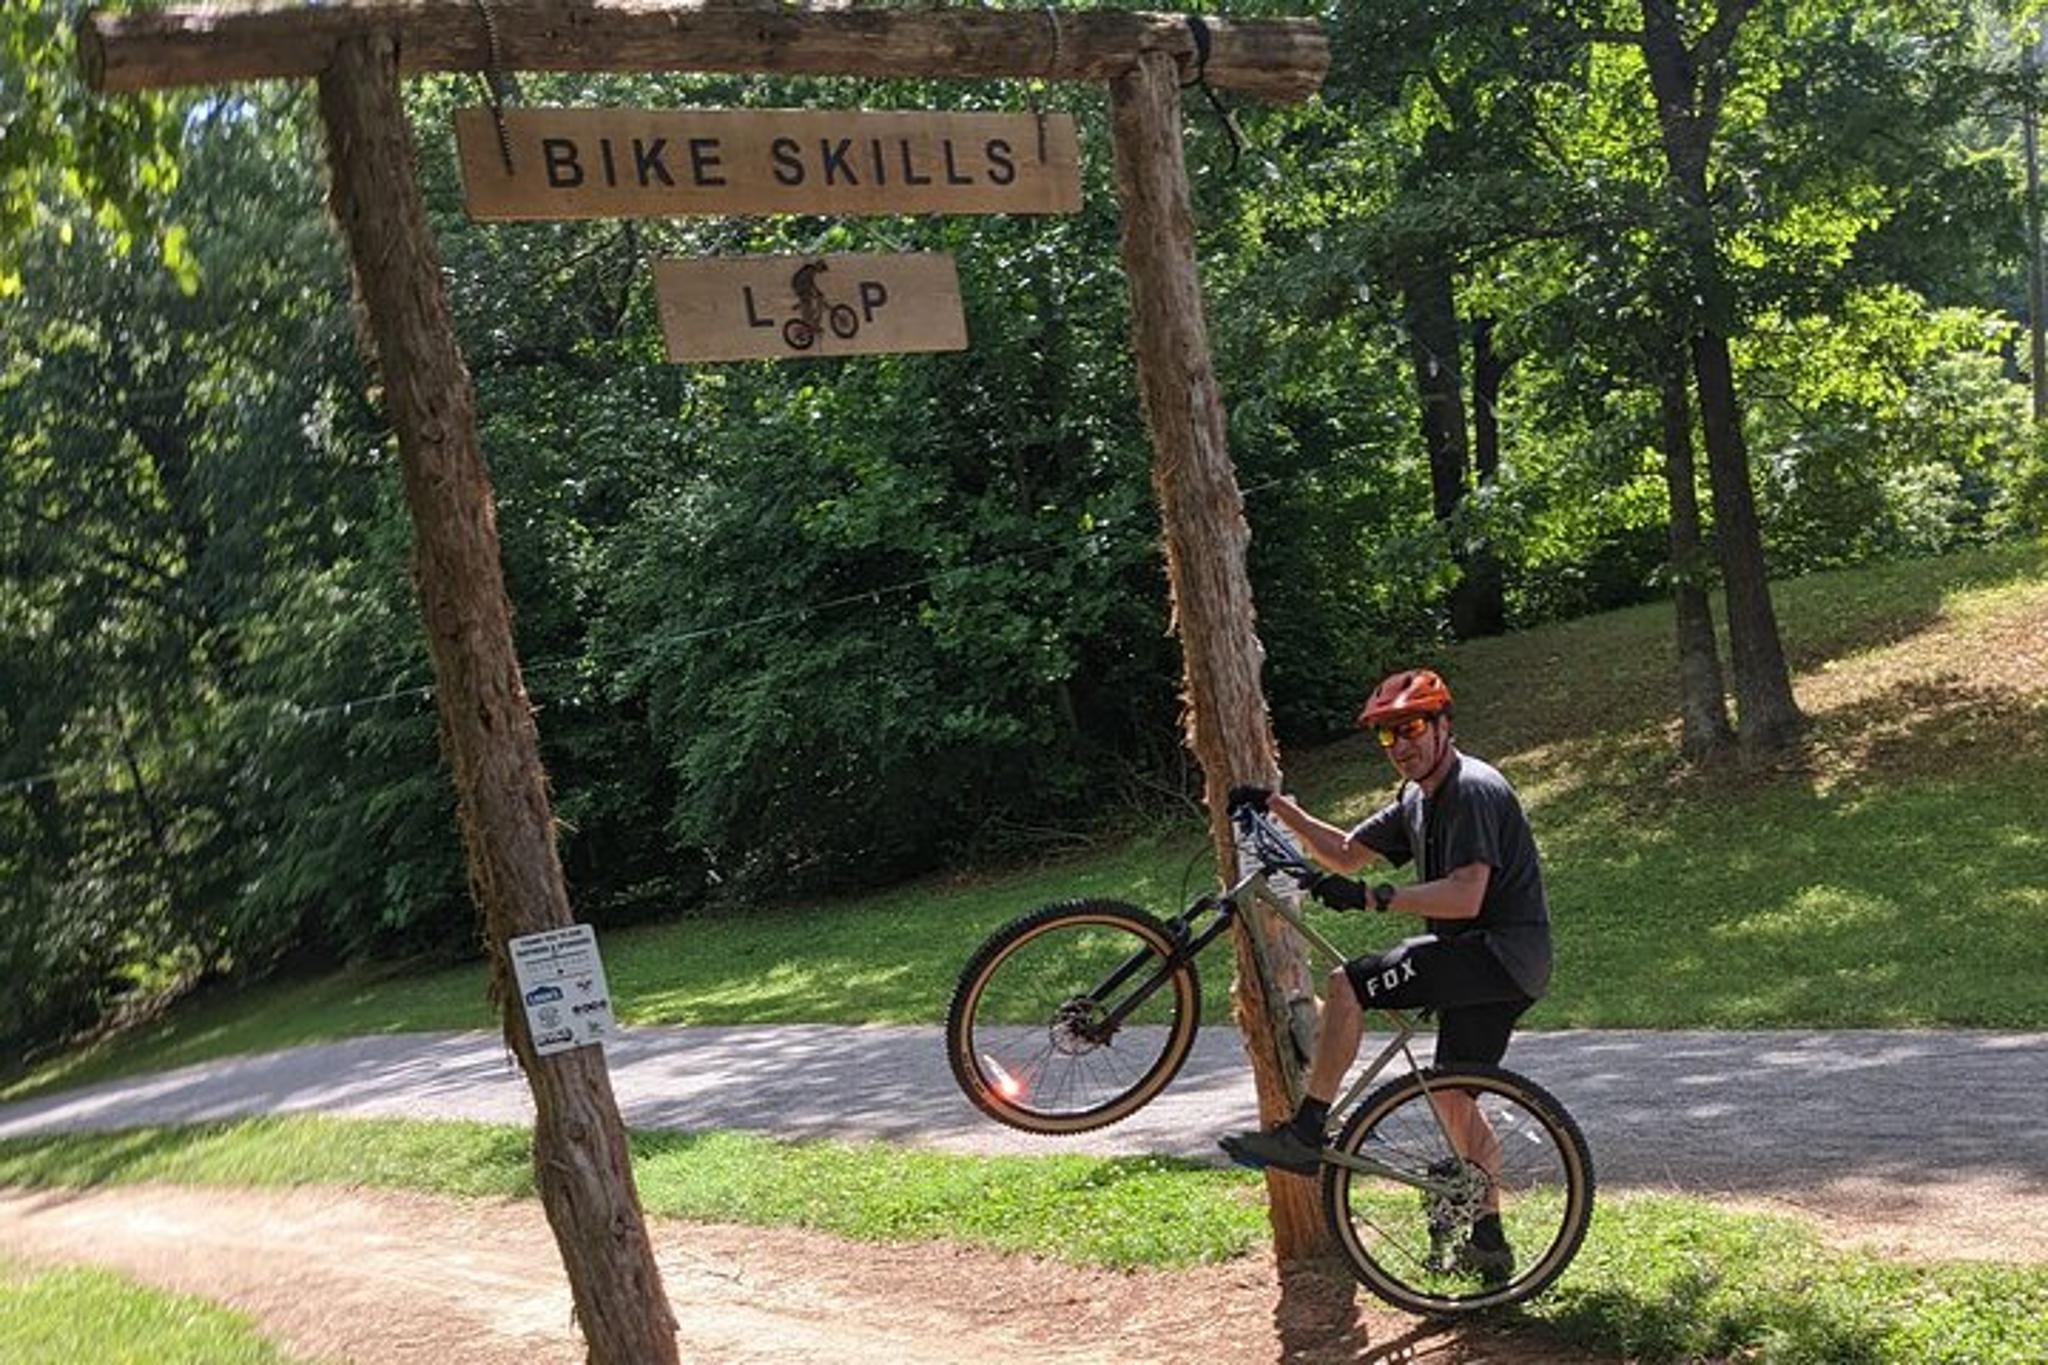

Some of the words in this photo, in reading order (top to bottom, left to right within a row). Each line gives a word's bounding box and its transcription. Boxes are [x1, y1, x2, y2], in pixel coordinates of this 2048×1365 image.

[542, 138, 727, 189] BIKE
[772, 138, 1015, 187] SKILLS
[1366, 958, 1417, 997] FOX
